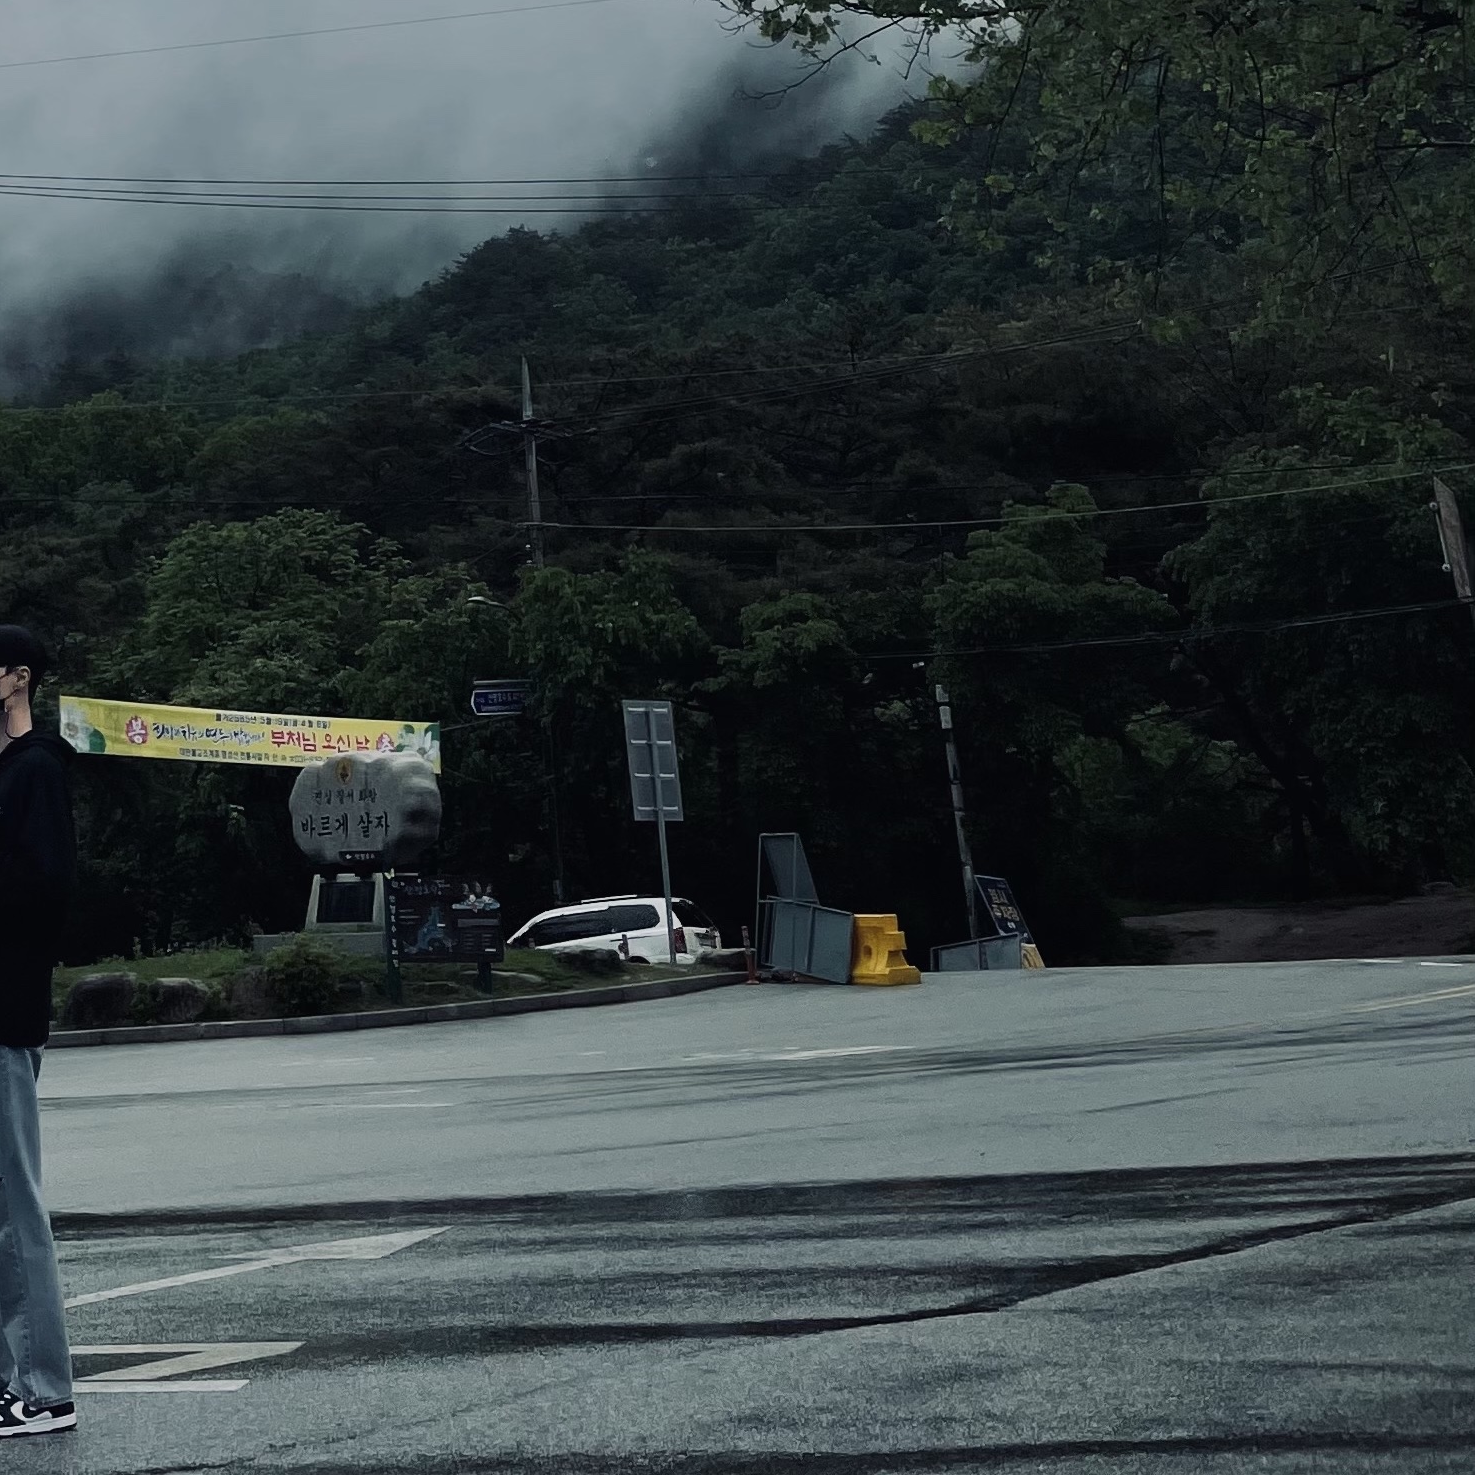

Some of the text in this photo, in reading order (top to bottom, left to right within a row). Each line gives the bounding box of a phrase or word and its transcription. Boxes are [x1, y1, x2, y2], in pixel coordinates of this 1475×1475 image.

[128, 718, 147, 744] 봉
[270, 729, 317, 753] 부처님
[322, 732, 351, 754] 오신
[300, 810, 390, 840] 바르게 살자
